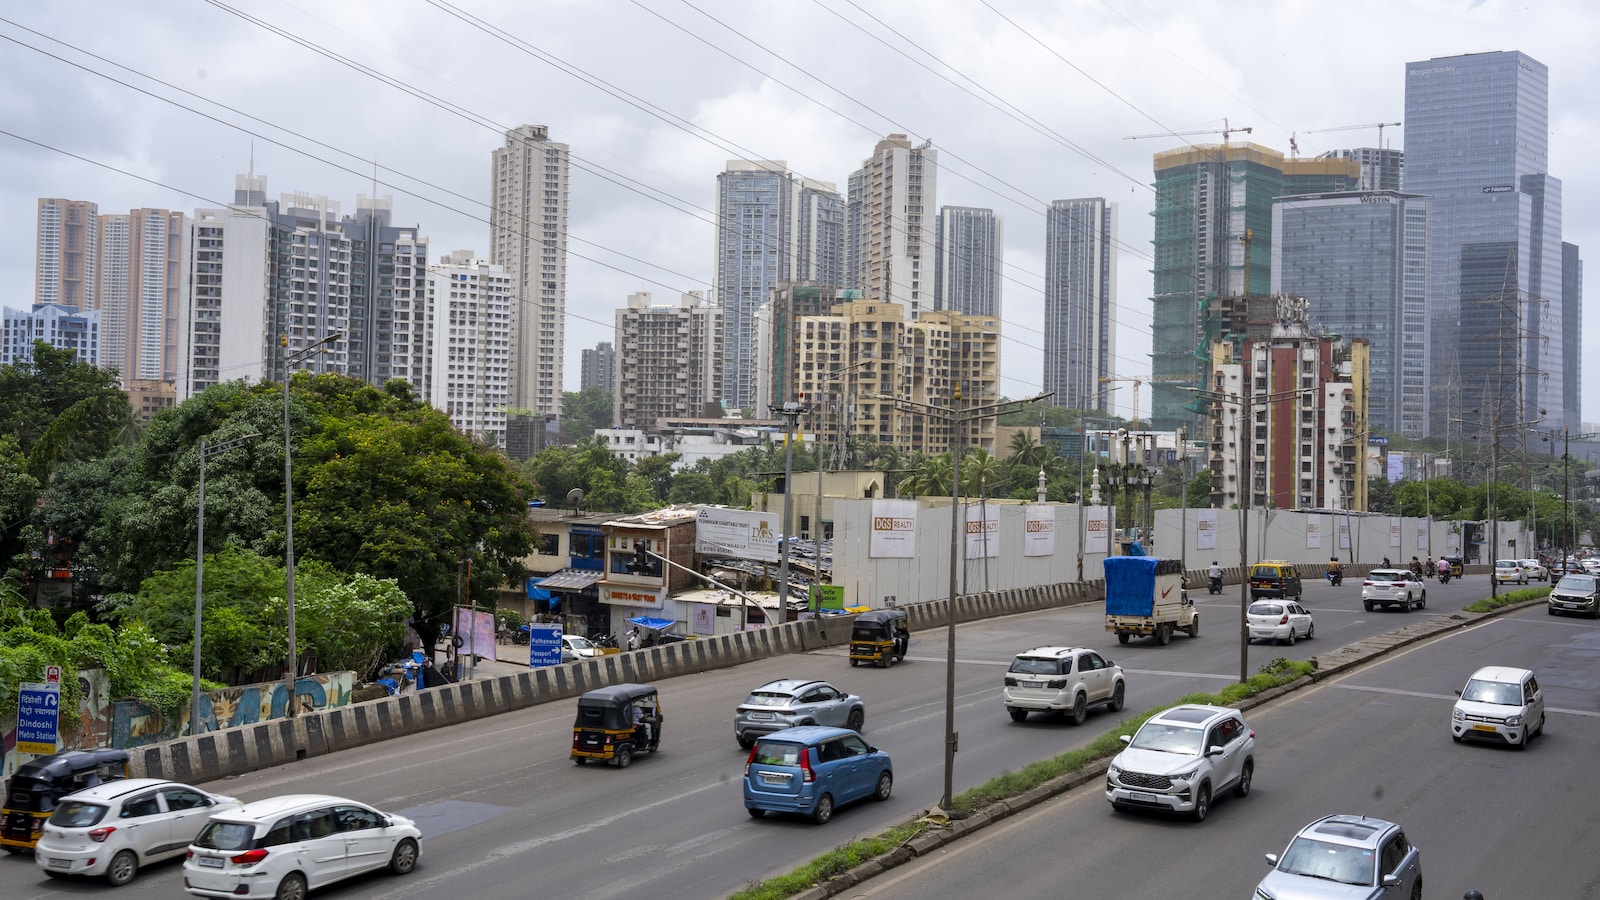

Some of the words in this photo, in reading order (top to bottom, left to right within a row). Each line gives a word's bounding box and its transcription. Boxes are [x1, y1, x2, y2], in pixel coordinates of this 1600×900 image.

[1409, 68, 1432, 76] Morgan
[1433, 65, 1455, 74] Stanley
[1360, 194, 1390, 204] WESTIN
[876, 518, 892, 530] DGS
[893, 520, 913, 529] REALTY
[967, 522, 981, 533] DGS
[1027, 521, 1039, 532] DGS
[1088, 520, 1100, 531] DGS
[752, 527, 774, 539] DGS
[20, 706, 32, 716] मेट्रो
[34, 708, 58, 716] स्थानक
[20, 718, 52, 729] Dindoshi
[19, 730, 35, 739] Metro
[36, 731, 56, 740] Station
